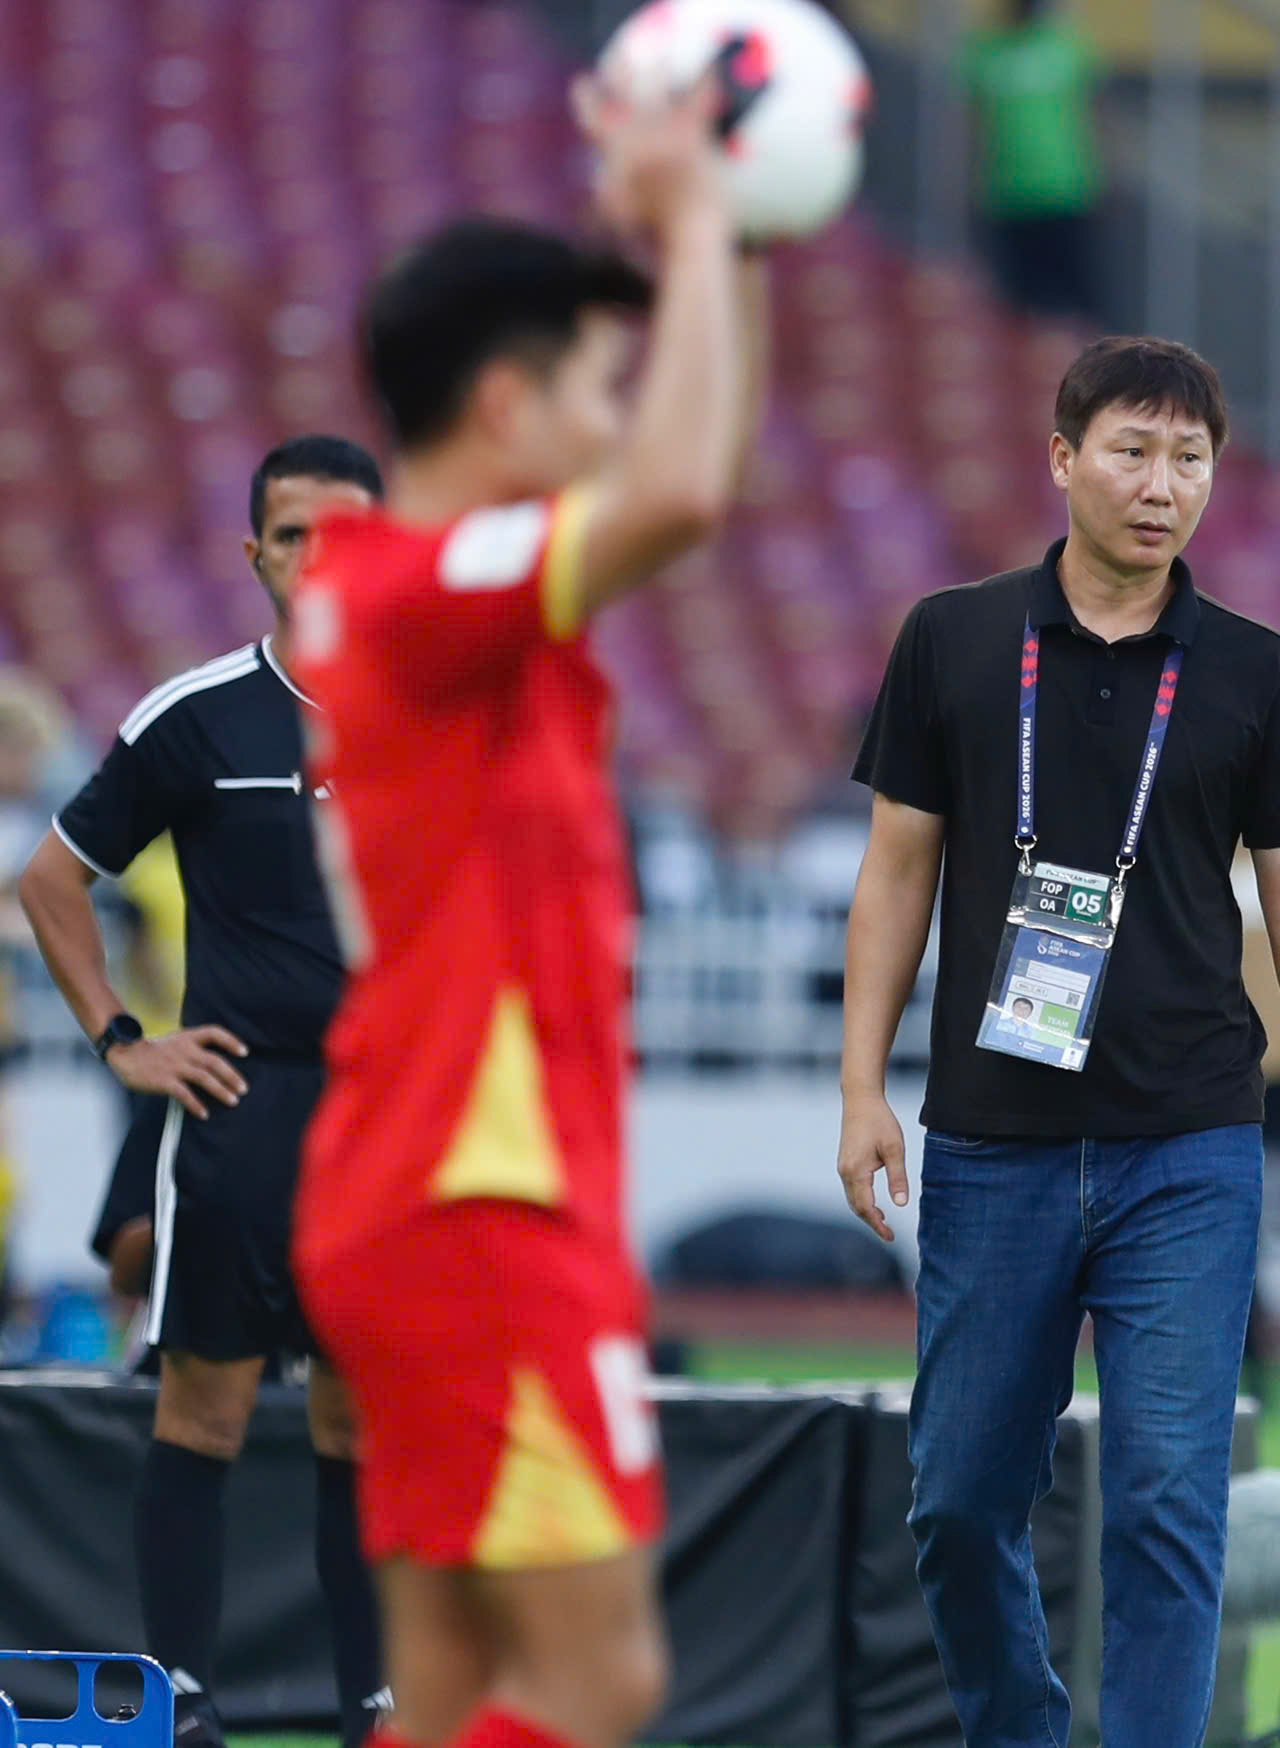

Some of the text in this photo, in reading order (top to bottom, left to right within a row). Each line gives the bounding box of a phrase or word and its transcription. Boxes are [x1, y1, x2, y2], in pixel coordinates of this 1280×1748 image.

[1022, 717, 1032, 739] FIFA
[1022, 739, 1031, 772] ASEAN
[1022, 773, 1031, 793] CUP
[1140, 771, 1151, 791] CUP
[1132, 791, 1147, 824] ASEAN
[1126, 825, 1139, 846] FIFA
[1040, 881, 1063, 896] FOP
[1039, 898, 1056, 912] OA
[1071, 891, 1102, 914] 05
